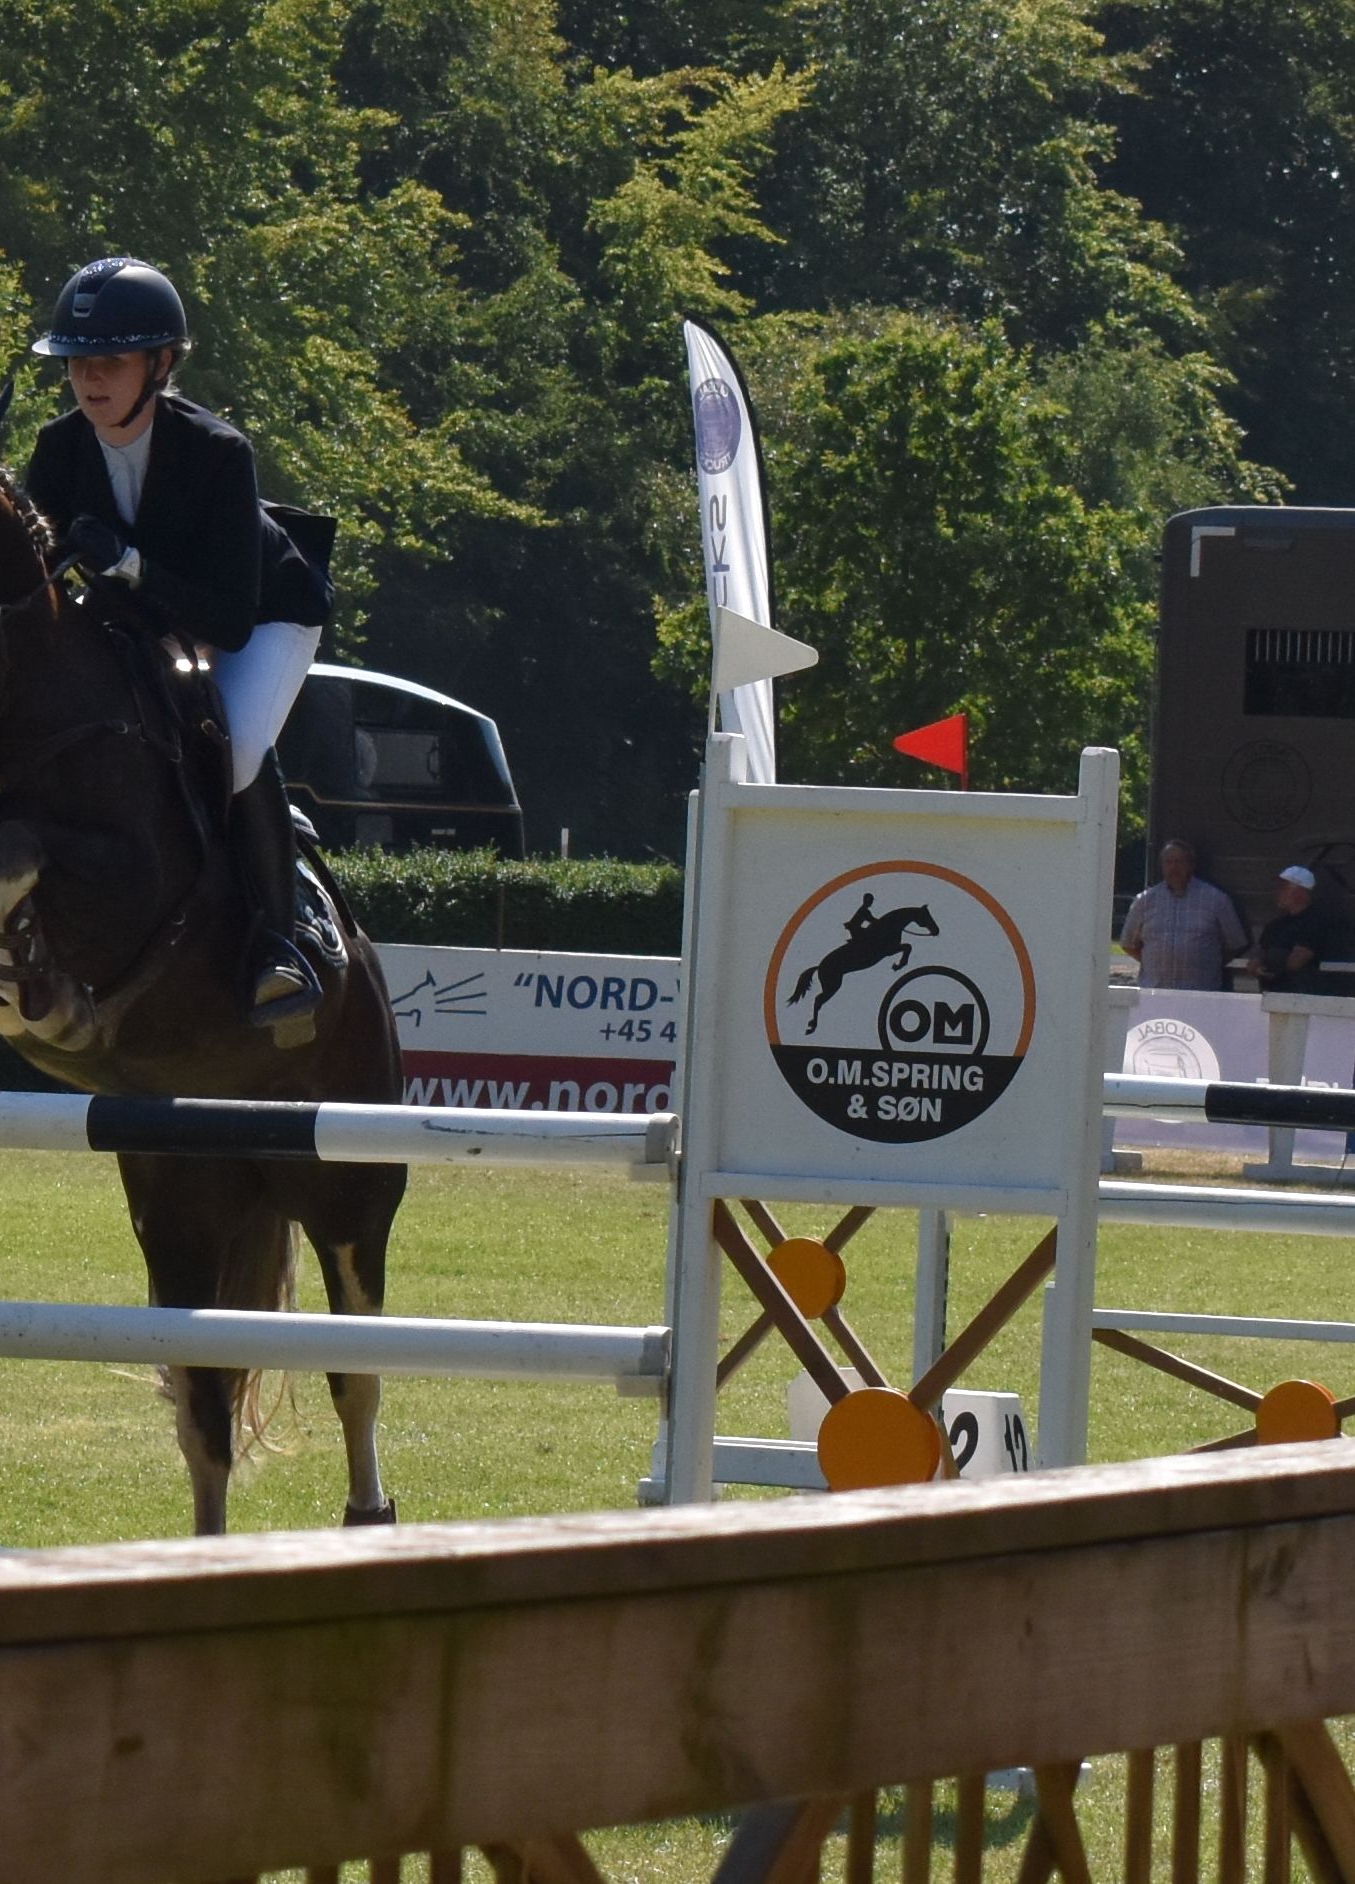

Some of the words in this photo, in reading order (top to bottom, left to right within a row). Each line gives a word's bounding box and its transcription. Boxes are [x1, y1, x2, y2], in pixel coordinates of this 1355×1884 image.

[513, 973, 681, 1012] “NORD-
[600, 1019, 652, 1043] +45
[660, 1021, 677, 1043] 4
[889, 999, 975, 1046] OM
[806, 1058, 984, 1091] O.M.SPRING
[847, 1094, 868, 1119] &
[877, 1096, 942, 1122] SØN
